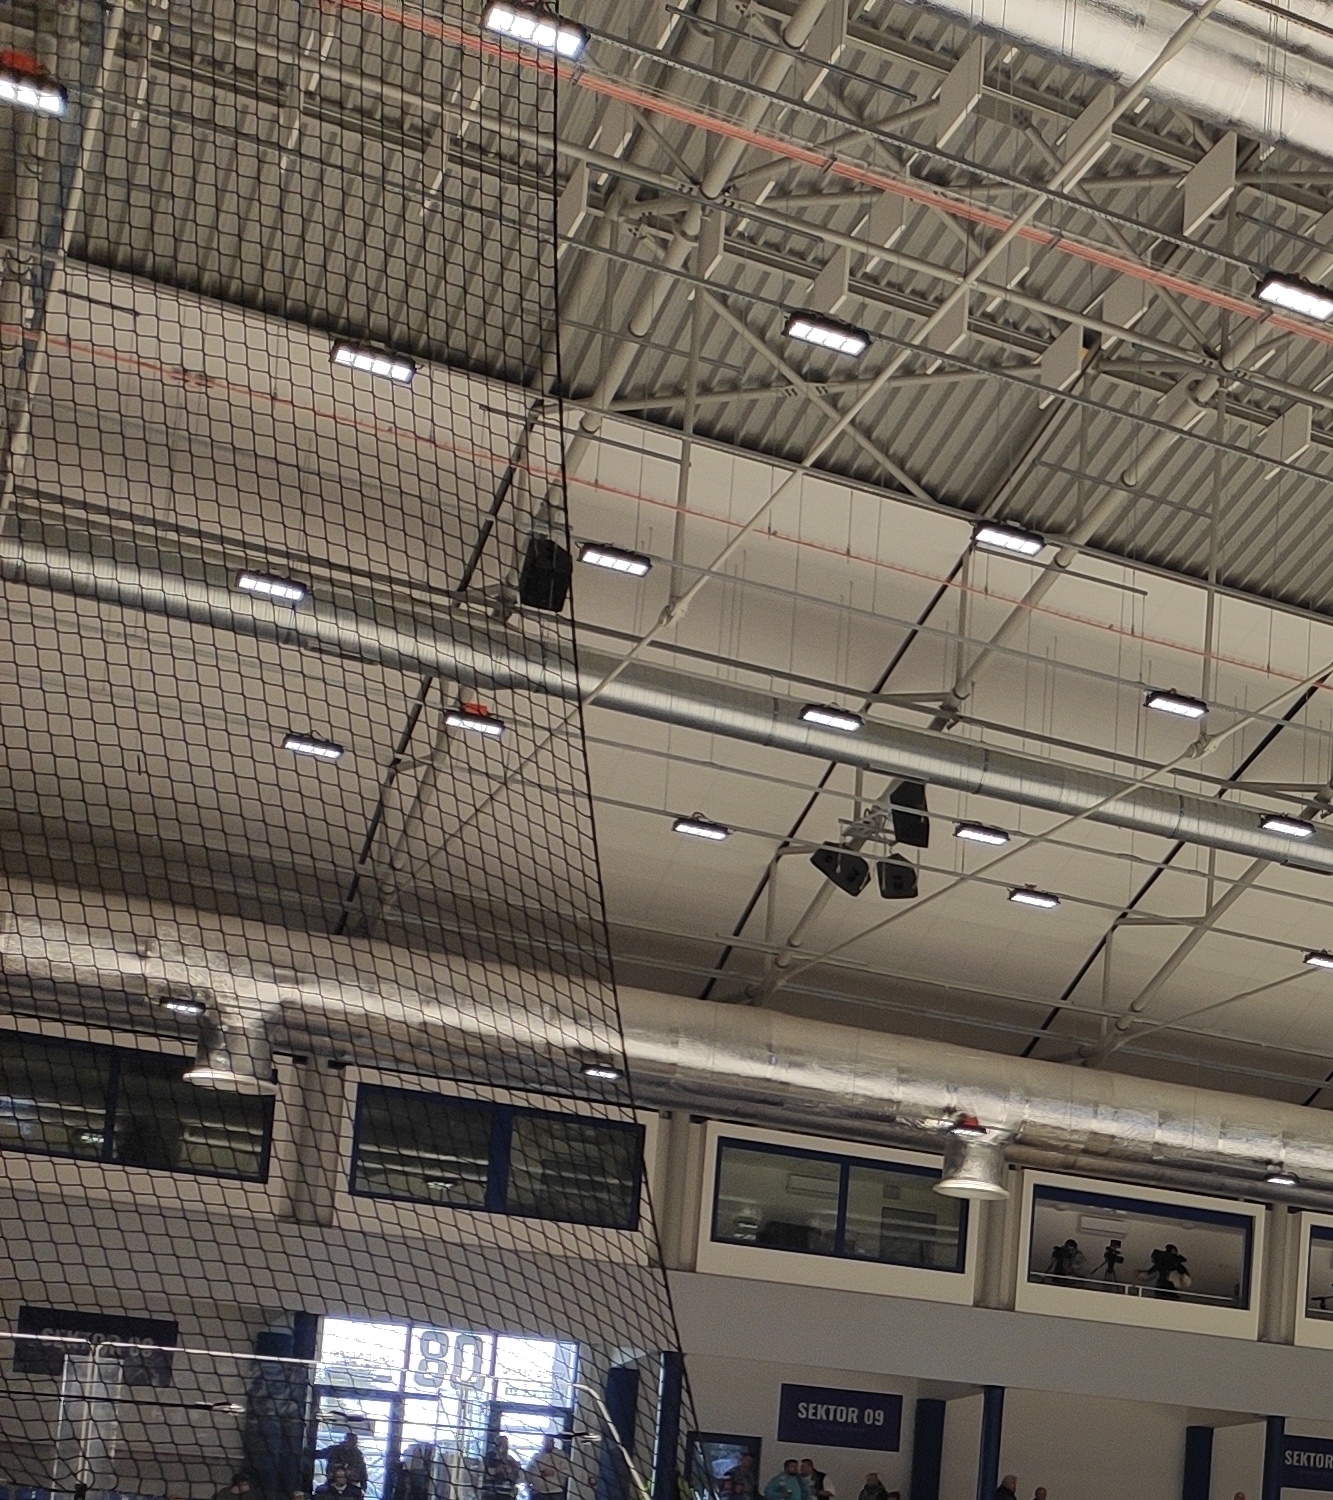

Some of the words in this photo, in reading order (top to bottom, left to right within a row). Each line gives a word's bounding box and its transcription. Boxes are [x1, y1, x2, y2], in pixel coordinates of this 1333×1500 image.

[797, 1402, 859, 1424] SEKTOR
[863, 1408, 885, 1426] 09
[1284, 1450, 1333, 1470] SEKTOR
